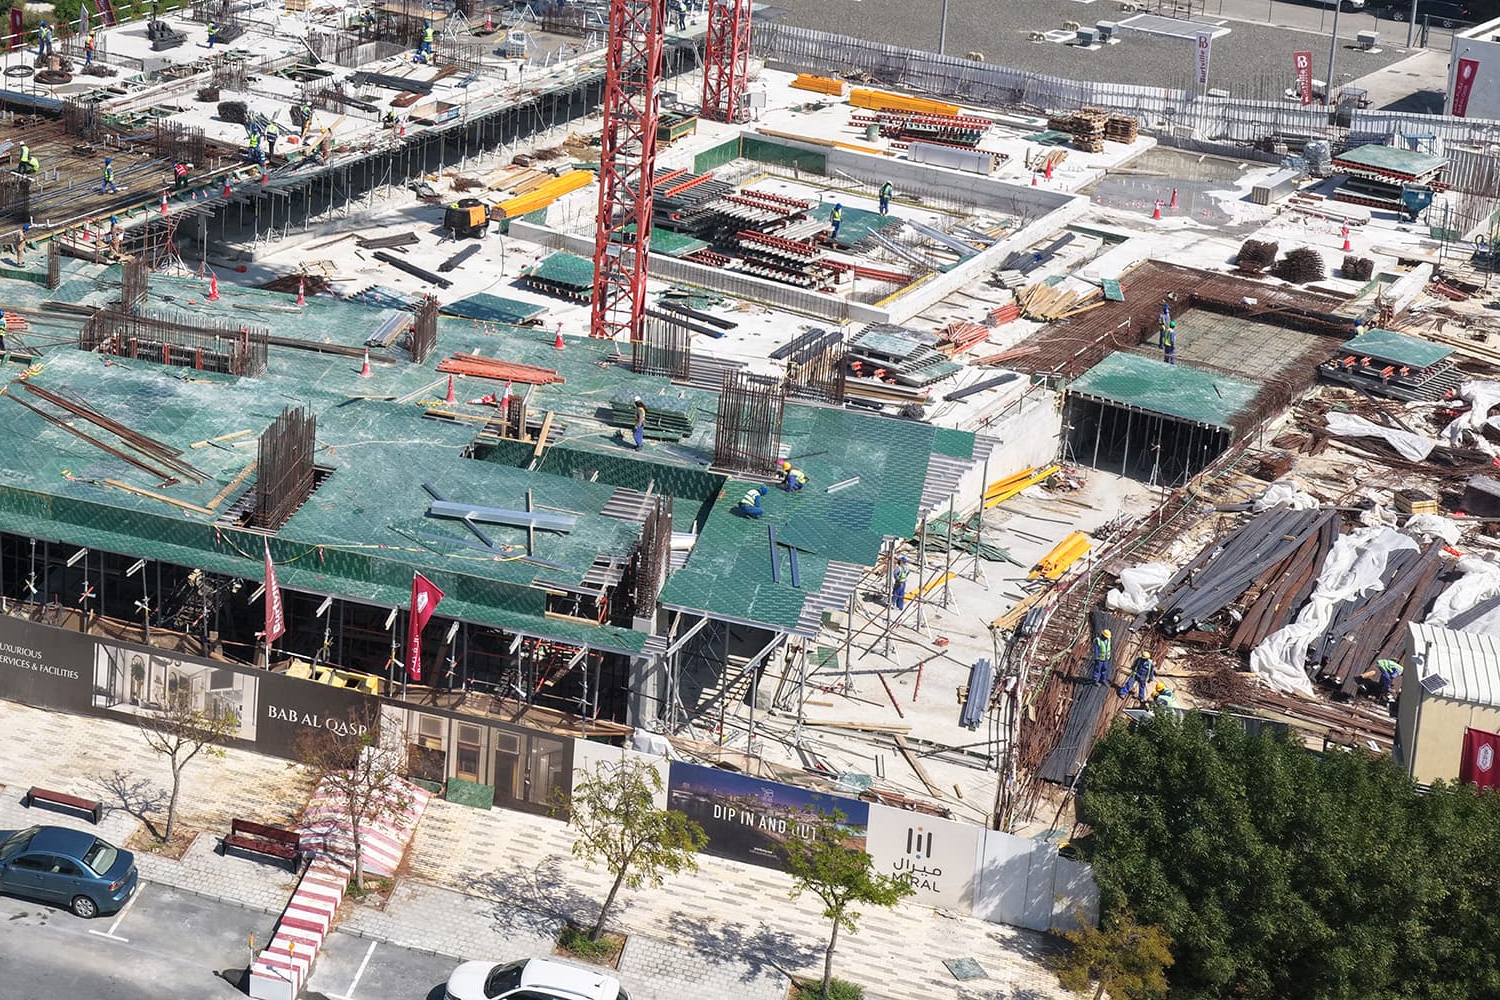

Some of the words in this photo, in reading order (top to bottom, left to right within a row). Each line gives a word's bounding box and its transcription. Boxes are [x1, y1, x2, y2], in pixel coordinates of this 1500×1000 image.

[31, 662, 38, 671] &
[39, 664, 79, 680] FACILITIES
[268, 705, 298, 722] BAB
[301, 713, 322, 728] AL
[325, 718, 367, 737] QASR
[713, 804, 736, 822] DIP
[740, 811, 754, 826] IN
[758, 815, 786, 834] AND
[893, 857, 941, 876] ميرال
